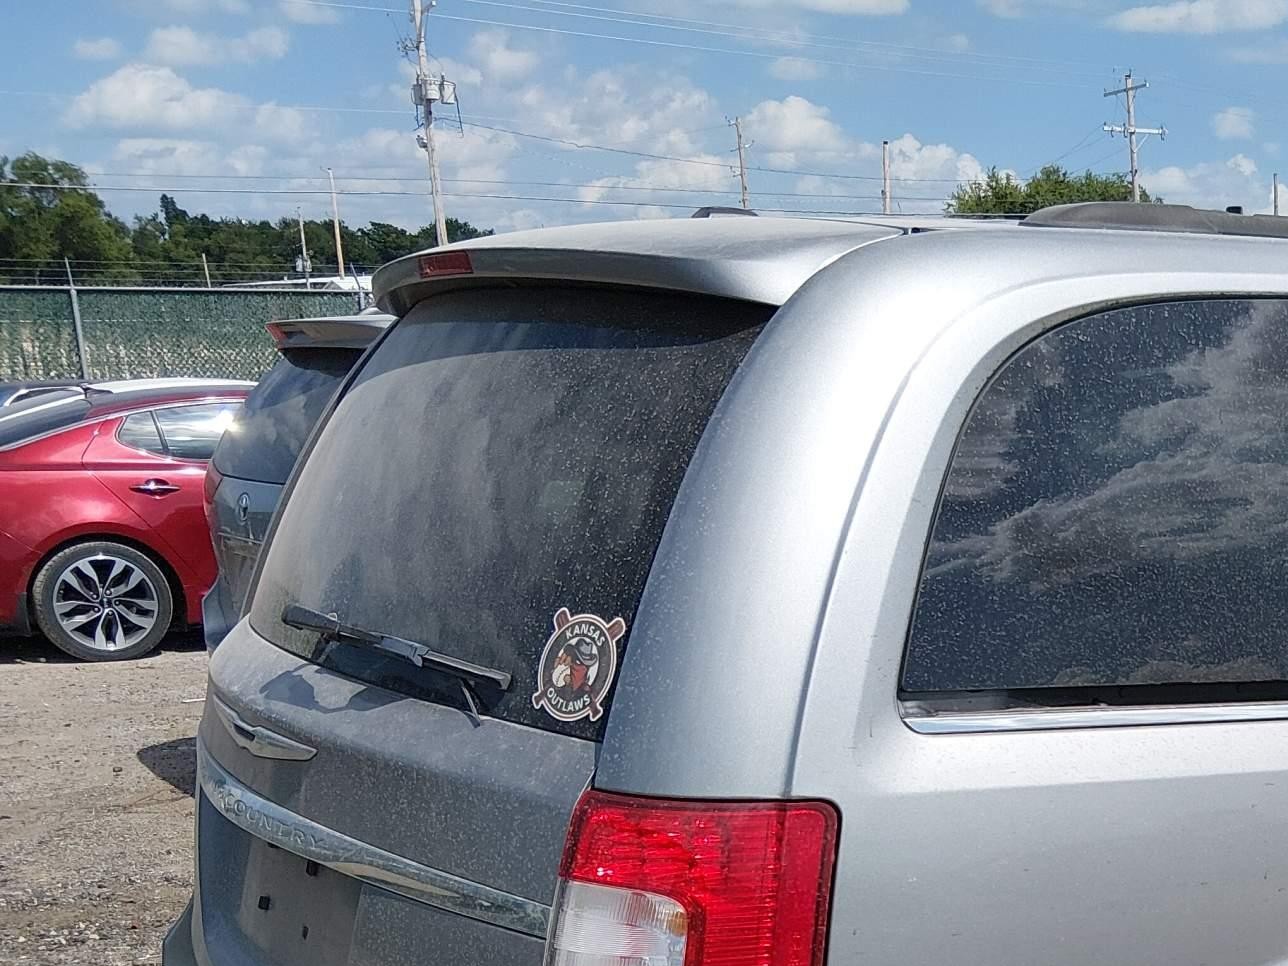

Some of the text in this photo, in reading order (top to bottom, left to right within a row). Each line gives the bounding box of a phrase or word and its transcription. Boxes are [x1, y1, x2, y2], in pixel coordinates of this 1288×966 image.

[565, 623, 605, 647] KANSAS
[546, 687, 591, 712] OUTLAWS
[225, 792, 329, 850] COUNTRY
